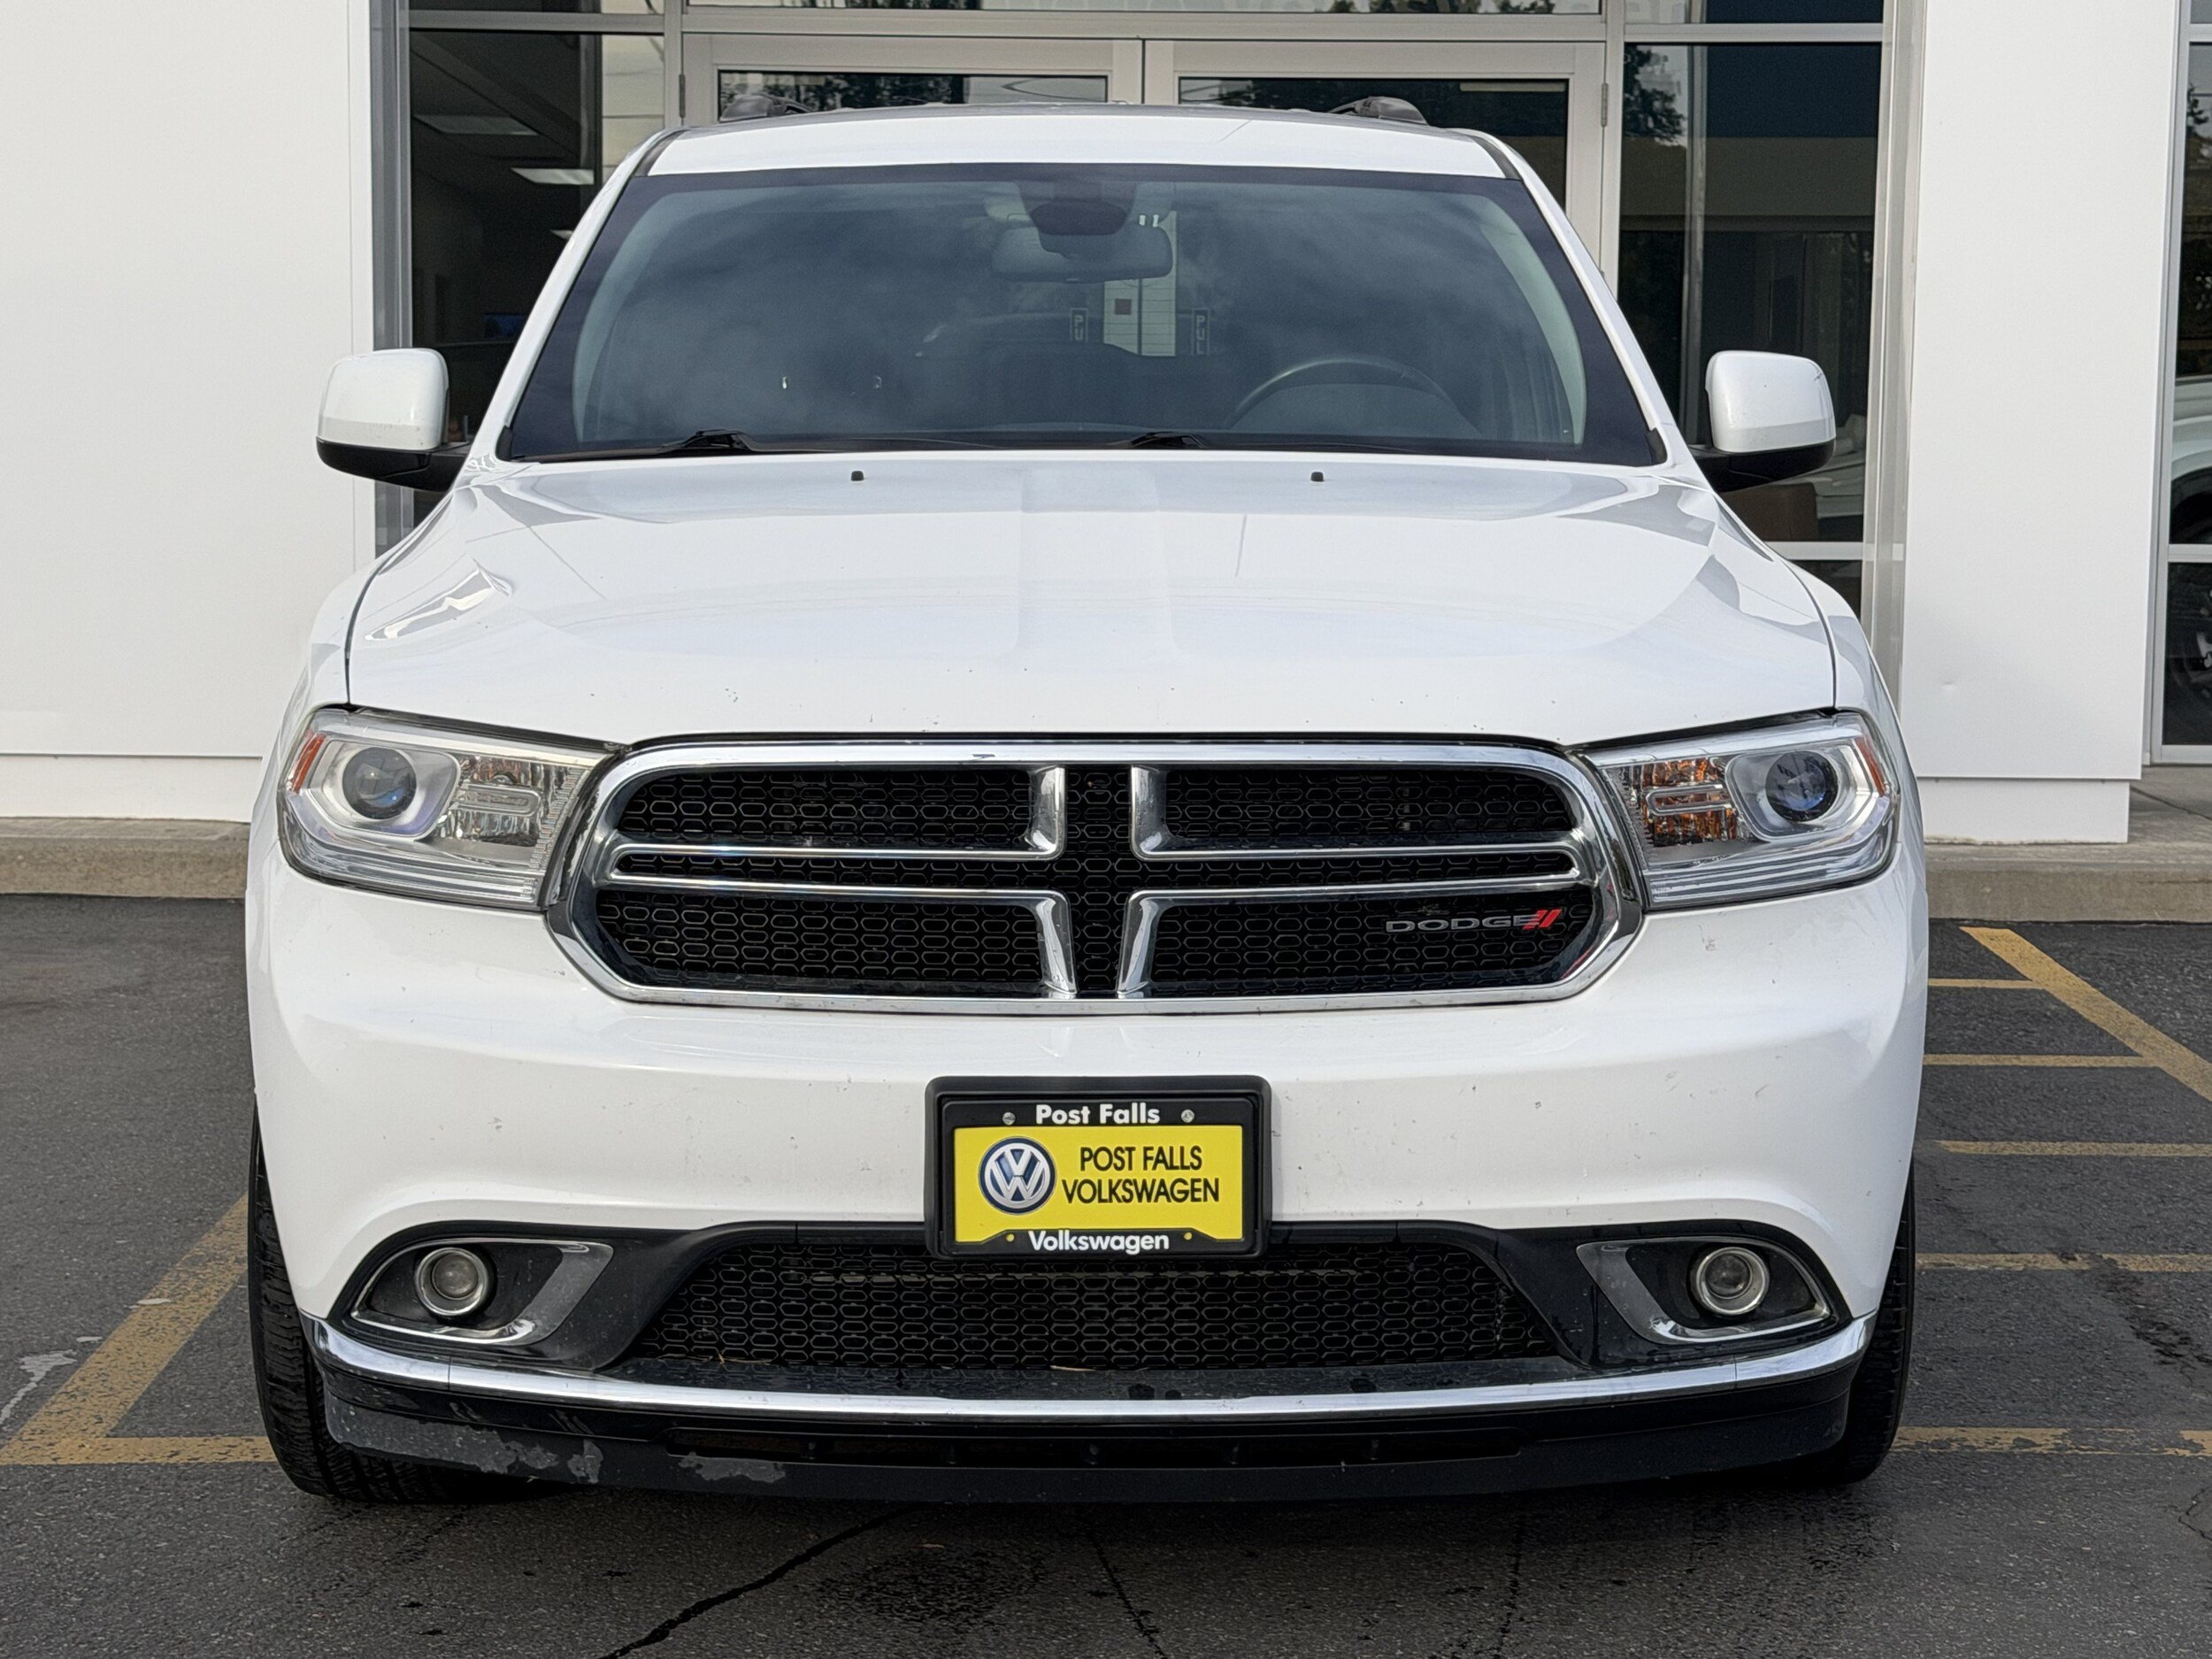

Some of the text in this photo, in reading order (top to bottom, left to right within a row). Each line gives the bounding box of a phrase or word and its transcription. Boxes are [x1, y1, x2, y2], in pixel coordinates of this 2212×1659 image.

[1386, 914, 1540, 933] DODGE
[1035, 1102, 1161, 1125] Post Falls
[1080, 1145, 1203, 1171] POST FALLS
[1061, 1178, 1220, 1204] VOLKSWAGEN
[1027, 1230, 1171, 1256] Volkswagen
